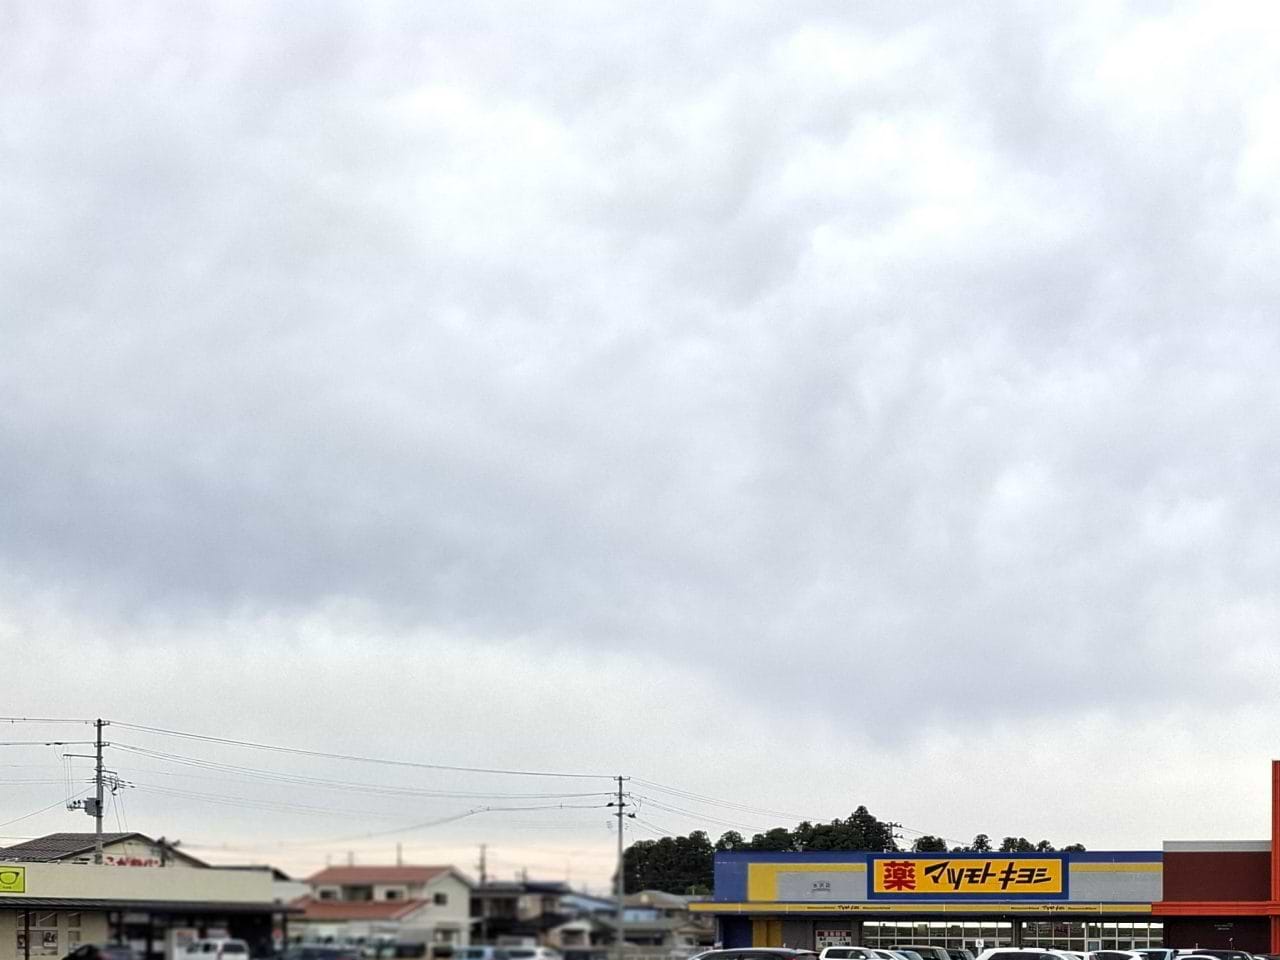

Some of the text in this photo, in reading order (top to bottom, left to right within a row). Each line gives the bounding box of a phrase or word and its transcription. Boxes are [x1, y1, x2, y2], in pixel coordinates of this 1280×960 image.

[883, 861, 1052, 891] 薬 マツモトキヨシ
